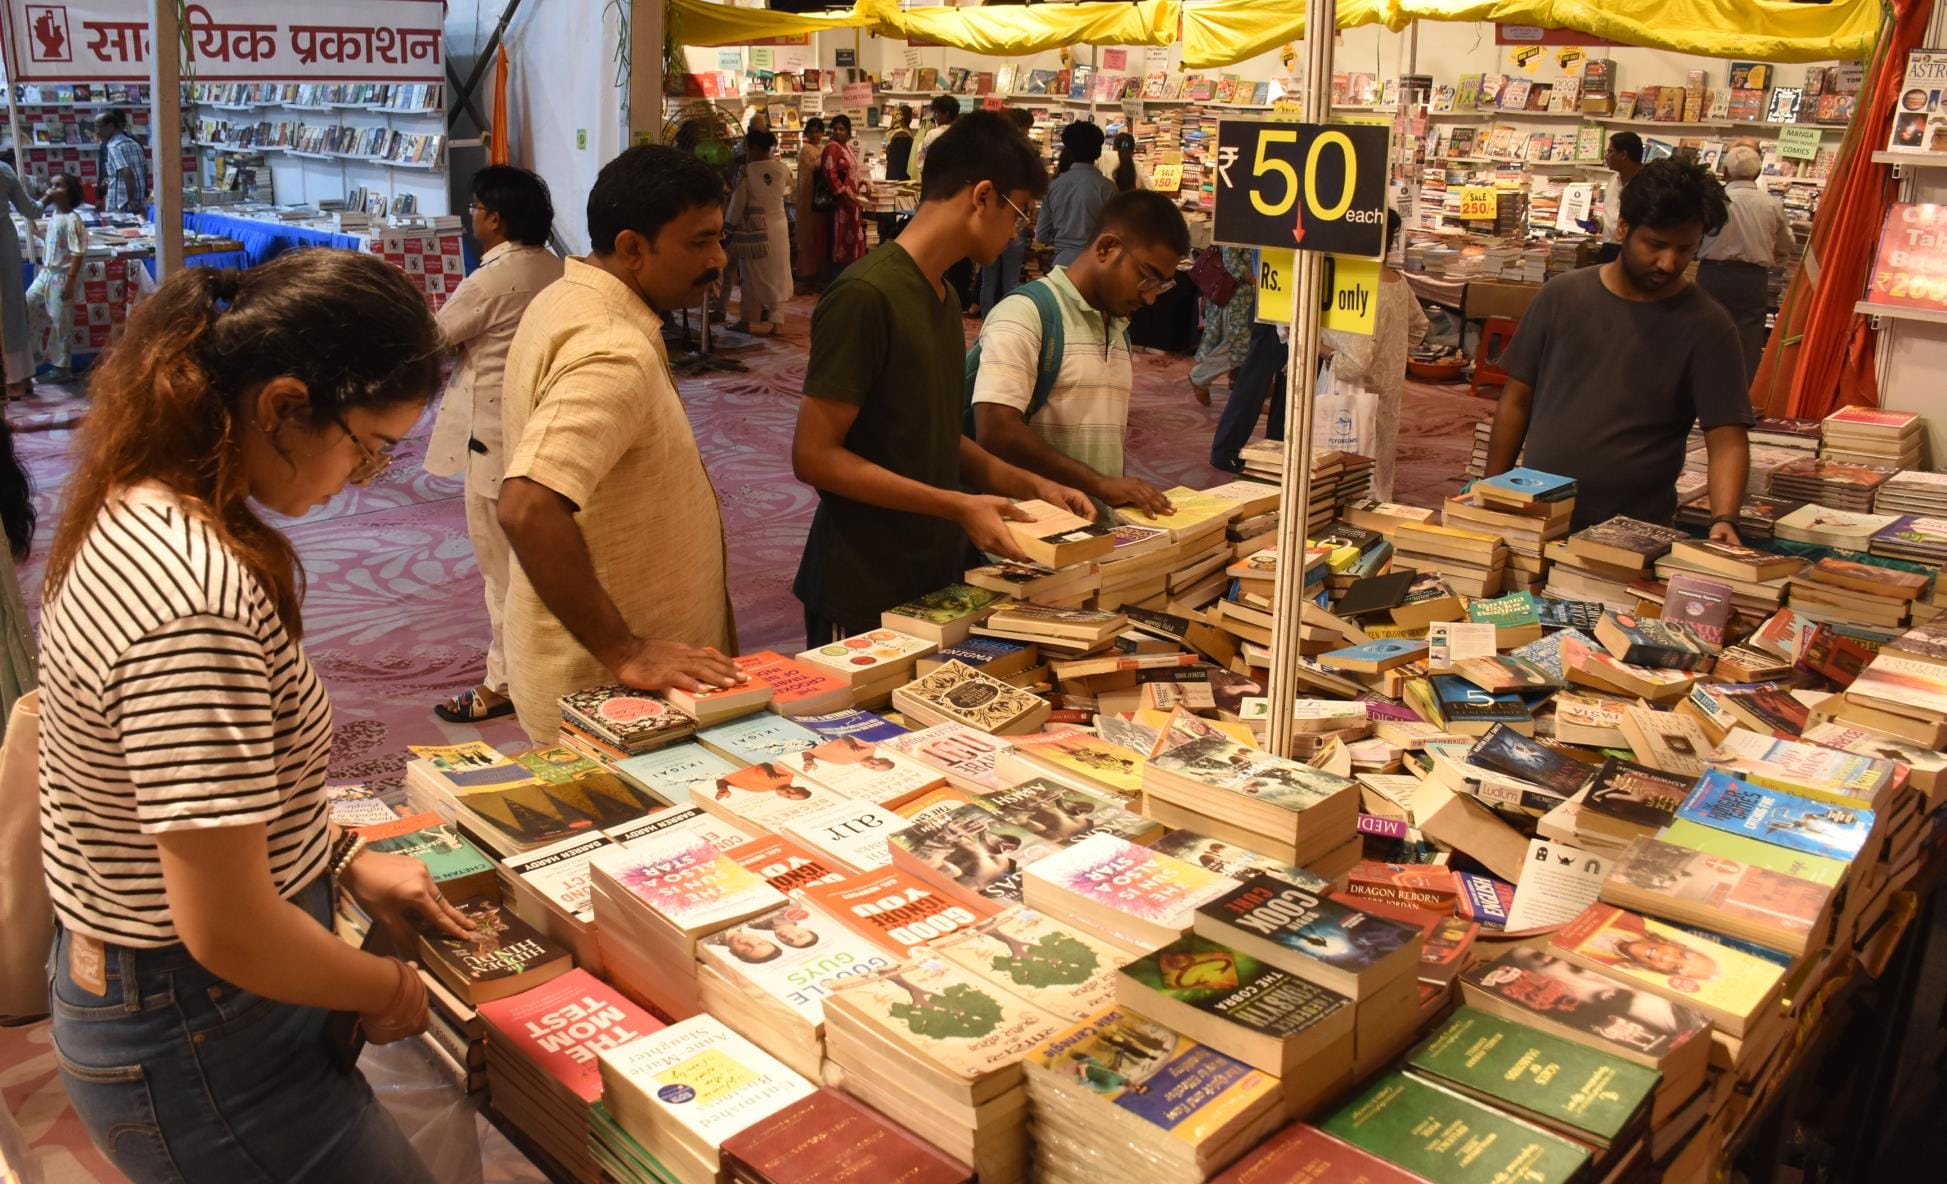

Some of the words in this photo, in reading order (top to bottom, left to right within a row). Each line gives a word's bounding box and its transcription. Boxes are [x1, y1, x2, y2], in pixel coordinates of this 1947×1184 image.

[83, 5, 277, 62] सायिक
[289, 25, 441, 66] प्रकाशन
[1908, 63, 1947, 78] ASTR
[1786, 129, 1814, 139] MANGA
[1782, 146, 1810, 155] COMICS
[1160, 169, 1175, 178] SALE
[1249, 129, 1358, 221] 50
[1345, 208, 1384, 224] each
[1470, 192, 1488, 201] SALE
[1462, 202, 1496, 215] 250/-
[1260, 262, 1282, 292] Rs.
[1338, 284, 1369, 318] only
[1477, 596, 1525, 609] Barbara
[1477, 604, 1531, 617] Bradford
[770, 675, 809, 688] TIMBE
[772, 677, 826, 695] CROOKE
[1467, 690, 1495, 708] 5
[1573, 707, 1618, 720] PASTA
[732, 727, 781, 747] IKIGAI
[651, 760, 704, 779] IKIGAI
[1616, 765, 1651, 780] SANGHI
[1651, 774, 1687, 788] ASHWIN
[990, 780, 1047, 808] AMISH
[1482, 785, 1518, 802] Ludlum
[656, 809, 696, 830] DARREN
[823, 814, 884, 842] air
[1357, 817, 1398, 834] MEDI
[624, 824, 657, 841] HARDY
[559, 840, 602, 859] DARREN
[442, 862, 487, 880] CHETAN
[524, 855, 559, 871] HARDY
[641, 854, 697, 877] STAR
[760, 856, 814, 878] YO
[1084, 855, 1135, 882] STAR
[641, 878, 658, 888] A
[766, 861, 826, 892] IGNO
[1092, 883, 1112, 894] A
[1350, 884, 1397, 898] DRAGON
[1398, 890, 1441, 904] REBORN
[1471, 876, 1506, 918] ENGLISH
[851, 887, 933, 918] YOU
[863, 893, 946, 927] IGNORE
[1223, 886, 1274, 914] CURE
[1234, 888, 1320, 935] COOK
[886, 907, 977, 945] GOOD
[462, 938, 537, 967] HINDU
[468, 945, 547, 974] HIDDEN
[787, 952, 856, 985] GUYS
[1255, 970, 1284, 988] THE
[1213, 984, 1259, 1012] COBRA
[1234, 979, 1321, 1028] FORSYTH
[524, 995, 609, 1040] TEST
[1094, 1010, 1124, 1029] Dale
[536, 1005, 627, 1054] MOM
[563, 1025, 639, 1064] THE
[628, 1027, 709, 1065] Slaughter
[1043, 1026, 1099, 1059] Carnegie
[628, 1031, 729, 1078] Anne-Marie
[695, 1073, 773, 1113] Business
[698, 1080, 796, 1129] Unfinished
